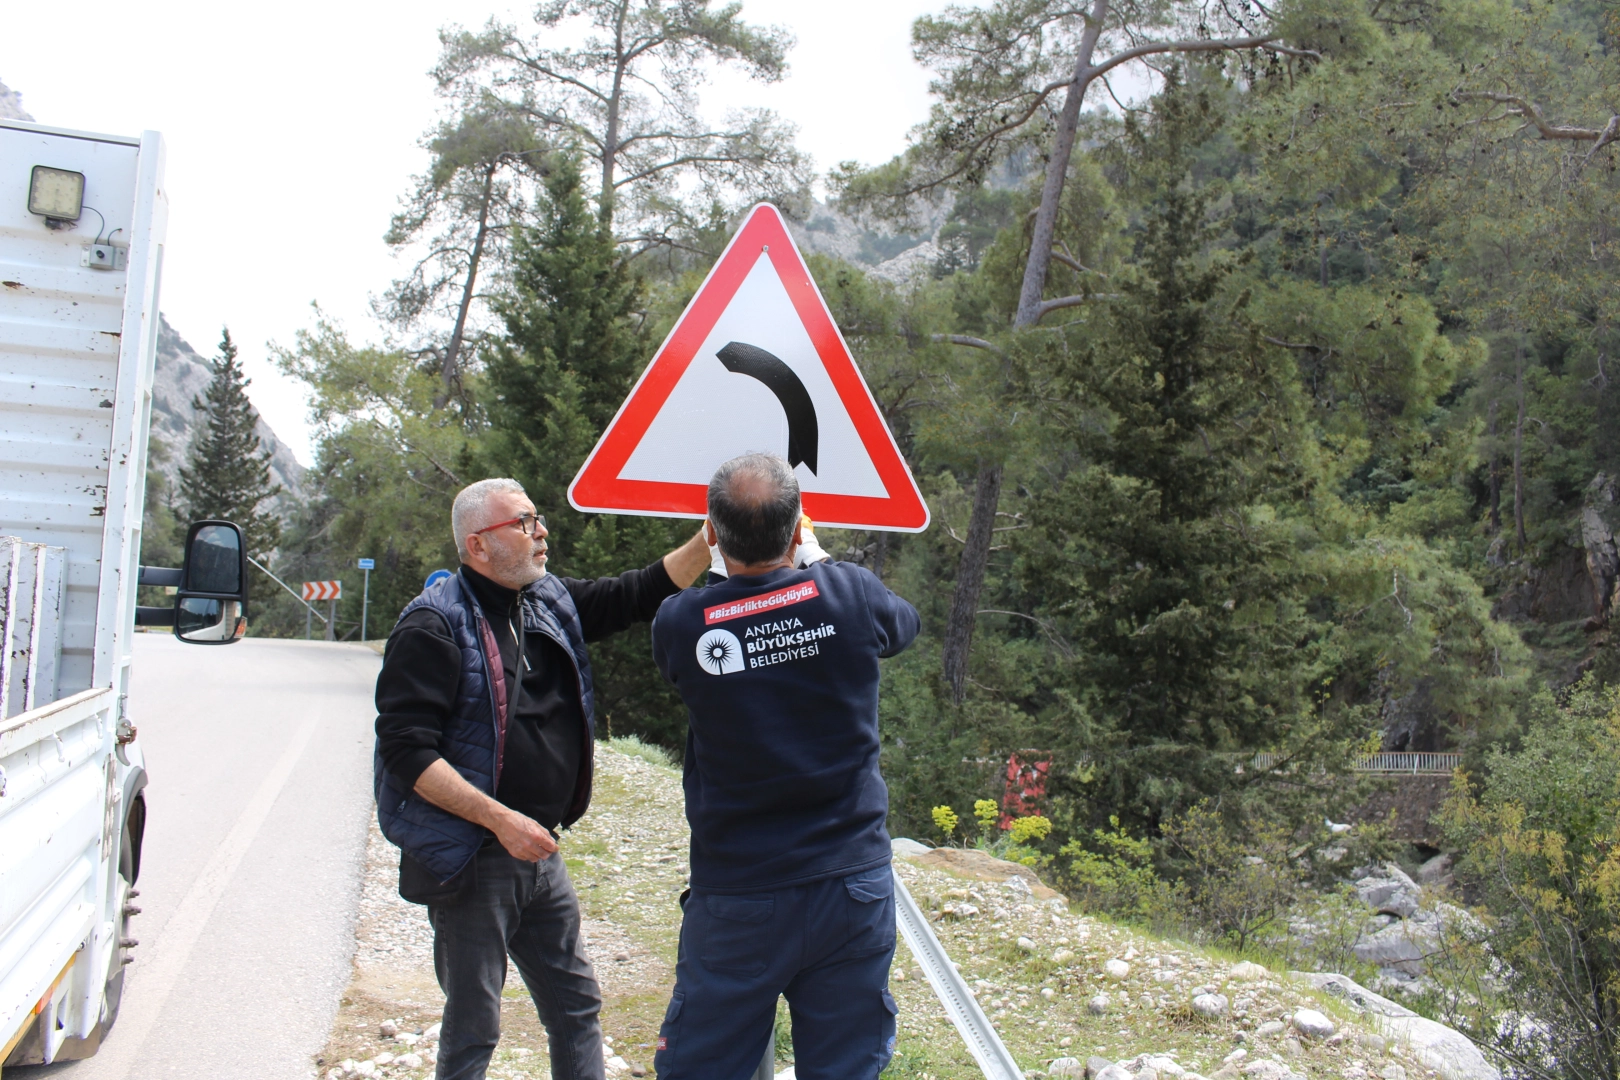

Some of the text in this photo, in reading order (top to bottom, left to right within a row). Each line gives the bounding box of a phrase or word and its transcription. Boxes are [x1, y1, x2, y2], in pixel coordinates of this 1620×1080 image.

[709, 586, 813, 620] #BizBirlikteGüçlüyüz
[744, 617, 803, 638] ANTALYA
[746, 622, 837, 654] BÜYÜKŞEHİR
[749, 641, 820, 669] BELEDİYESİ
